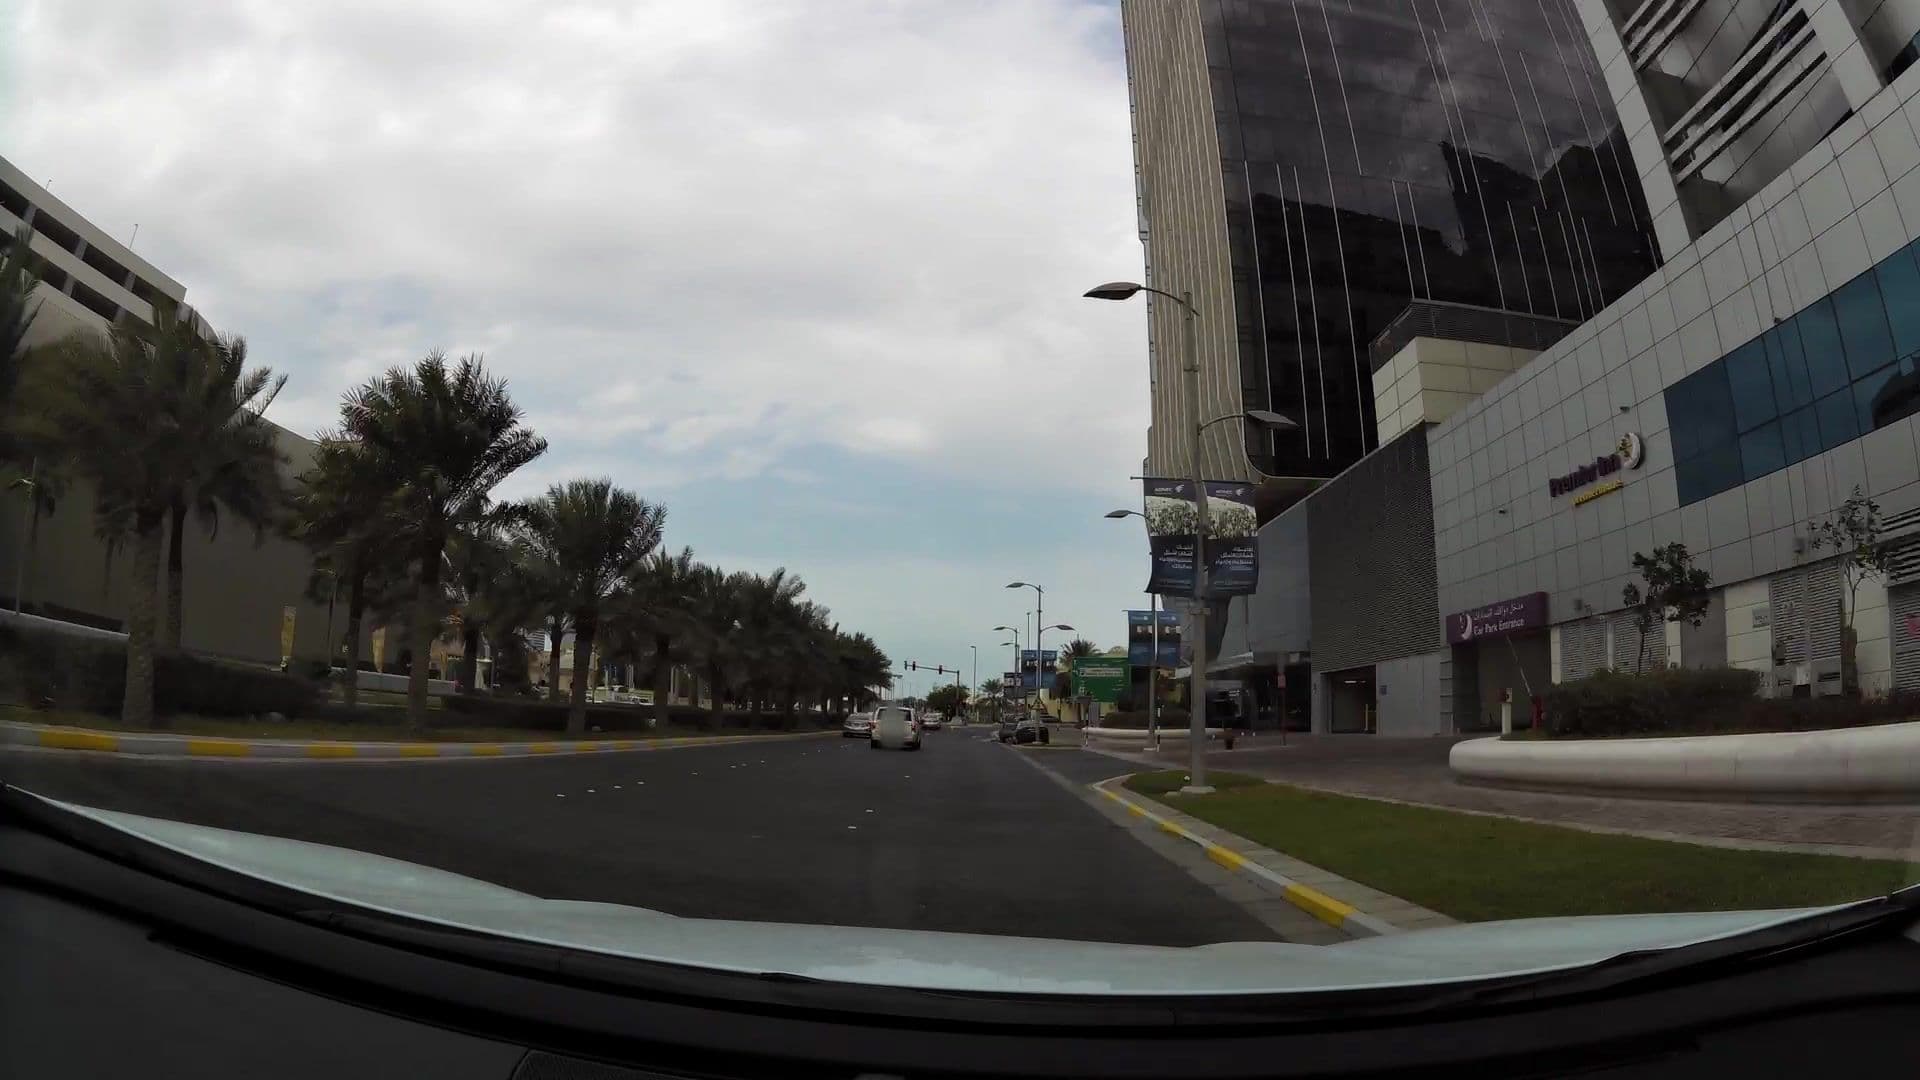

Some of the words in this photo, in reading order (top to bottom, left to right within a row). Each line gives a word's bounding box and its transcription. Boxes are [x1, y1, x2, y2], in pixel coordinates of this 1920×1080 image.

[1549, 464, 1598, 498] Premier
[1597, 453, 1621, 476] Inn
[1485, 623, 1498, 633] Park
[1499, 618, 1525, 631] Entrance
